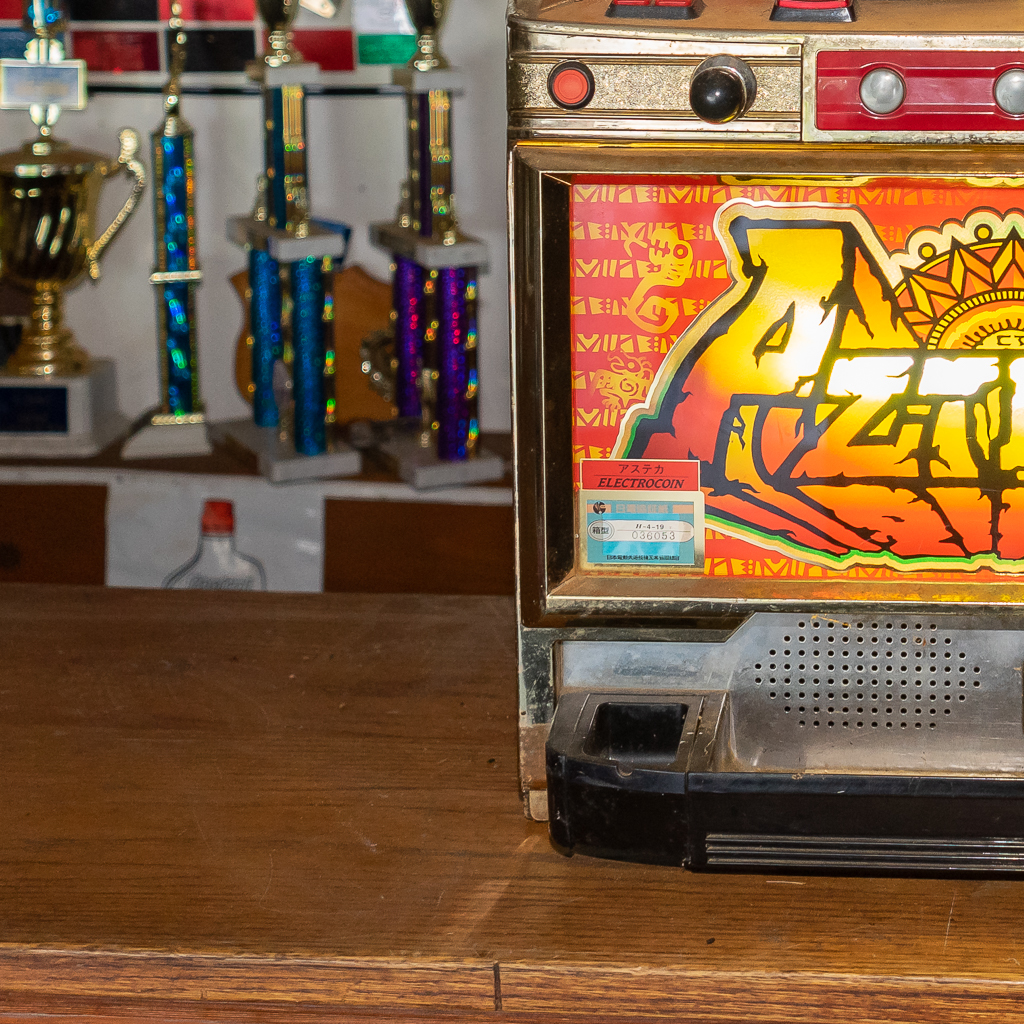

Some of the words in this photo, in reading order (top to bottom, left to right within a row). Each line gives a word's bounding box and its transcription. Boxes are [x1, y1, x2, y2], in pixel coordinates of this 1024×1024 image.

[618, 464, 664, 474] アステカ
[597, 478, 684, 488] ELECTROCOIN
[632, 530, 676, 540] 036053
